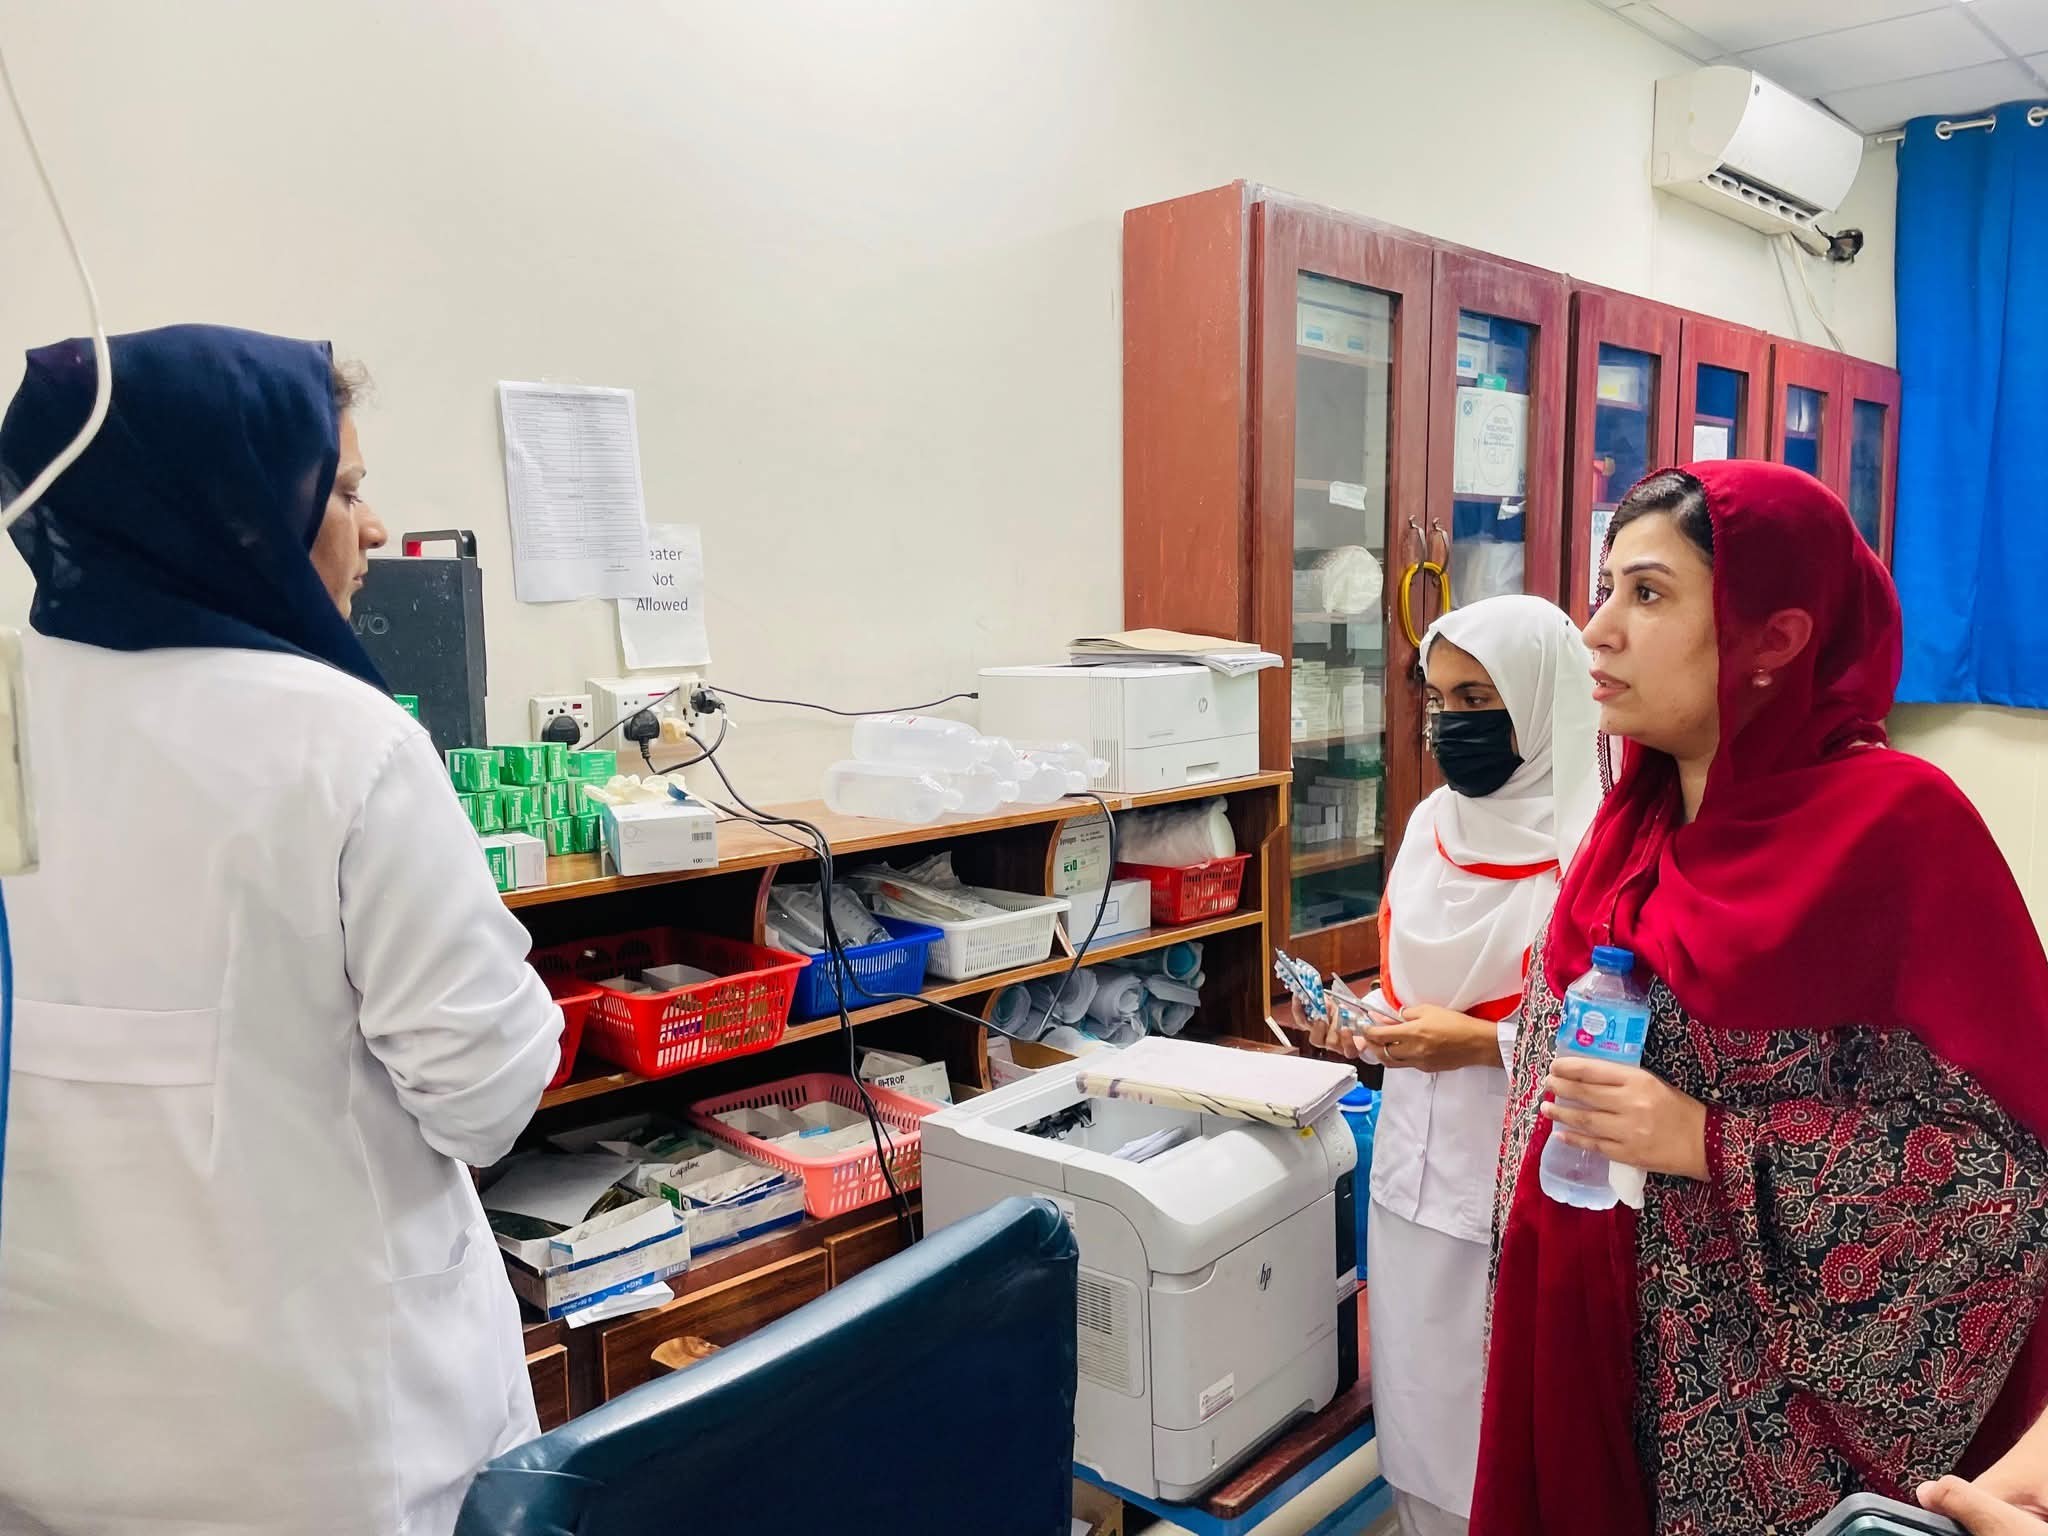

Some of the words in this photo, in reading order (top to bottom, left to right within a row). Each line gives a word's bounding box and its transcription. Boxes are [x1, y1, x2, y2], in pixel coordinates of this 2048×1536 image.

[652, 572, 675, 586] Not
[636, 597, 688, 611] Allowed
[1260, 1263, 1272, 1290] hp
